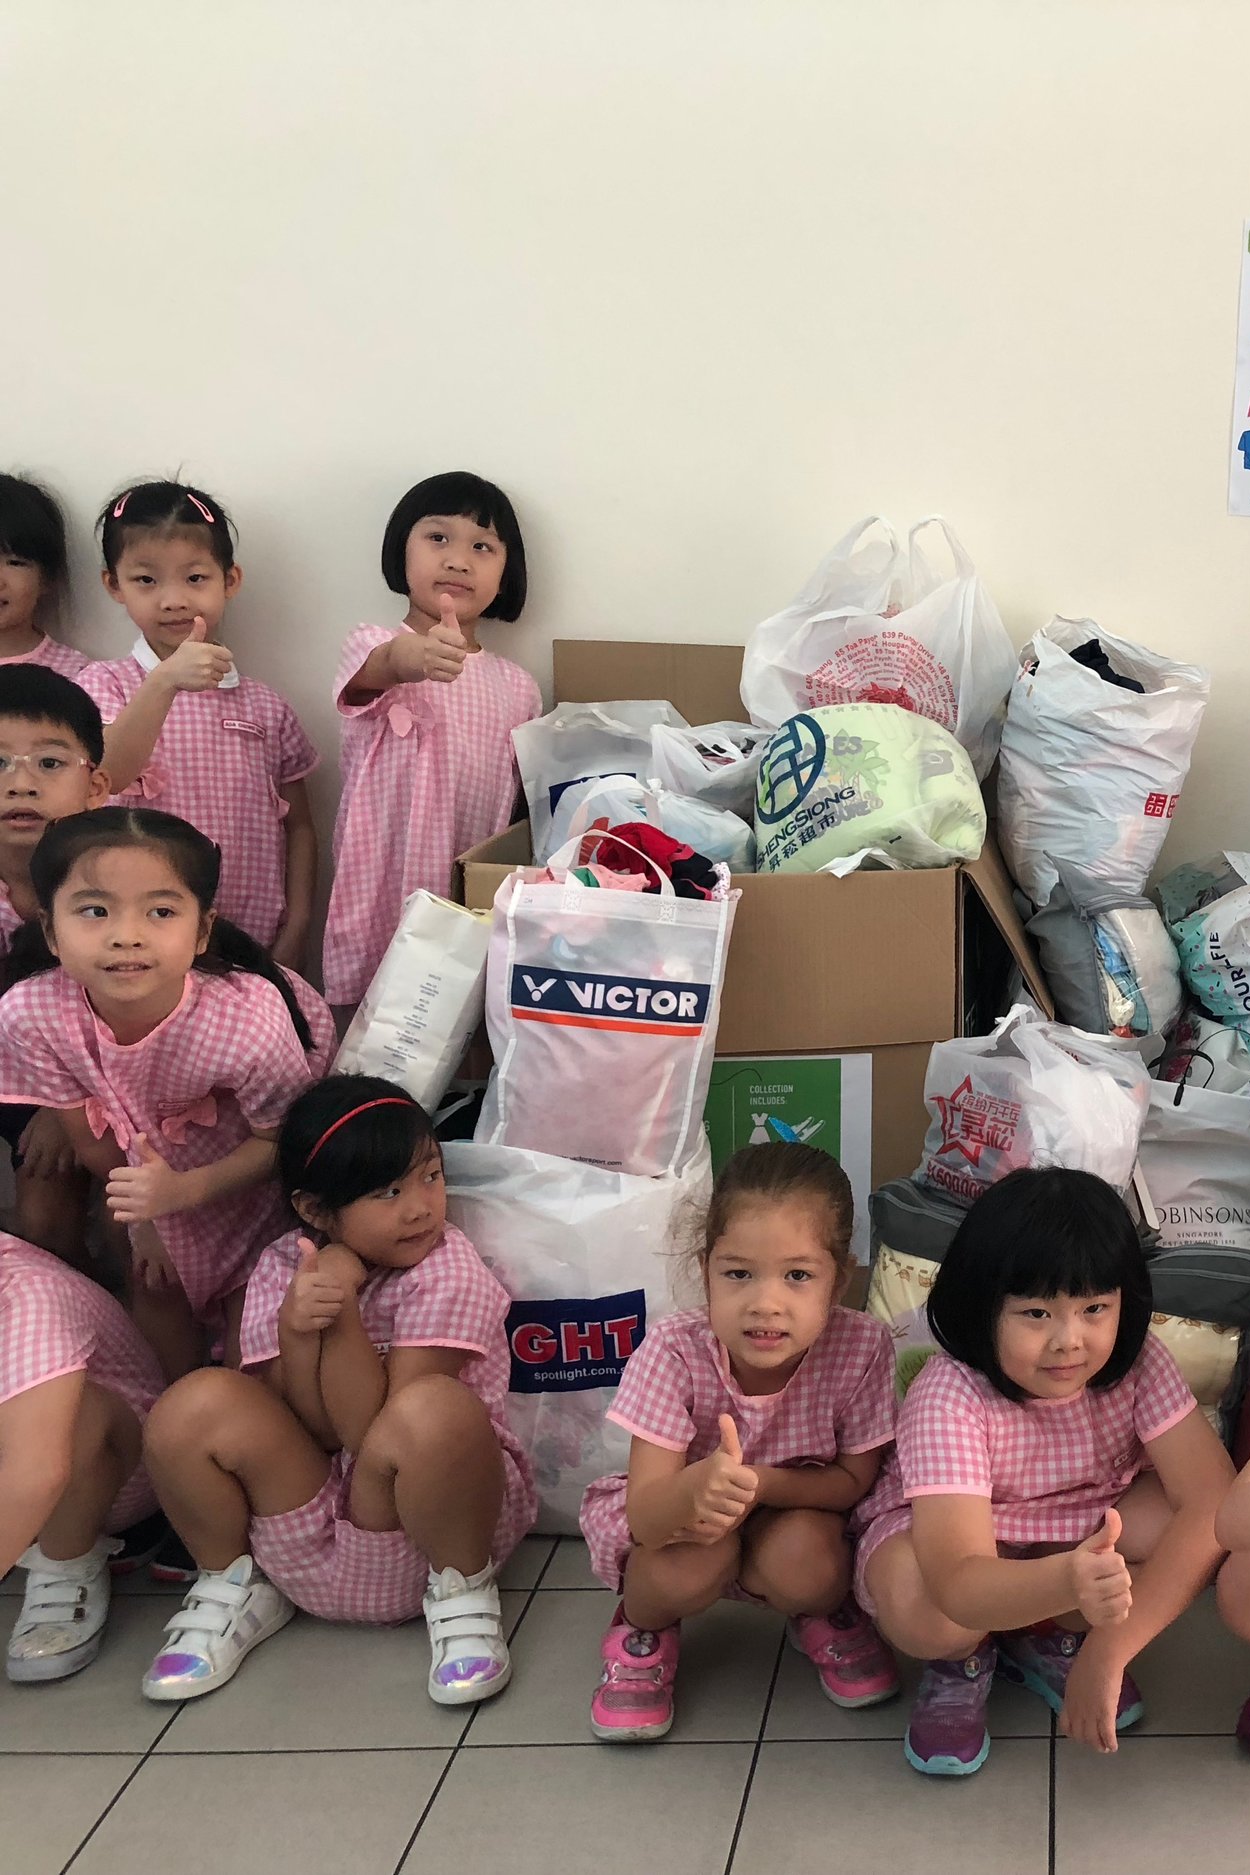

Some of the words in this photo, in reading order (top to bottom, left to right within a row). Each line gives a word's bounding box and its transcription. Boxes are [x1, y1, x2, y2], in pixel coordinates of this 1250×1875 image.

[834, 647, 846, 658] 85
[845, 641, 859, 652] Toa
[881, 631, 896, 639] 639
[917, 644, 935, 661] Drive
[943, 674, 956, 703] Potong
[564, 979, 699, 1018] VICTOR
[749, 1084, 794, 1094] COLLECTION
[534, 1366, 625, 1382] spotlight.com.s
